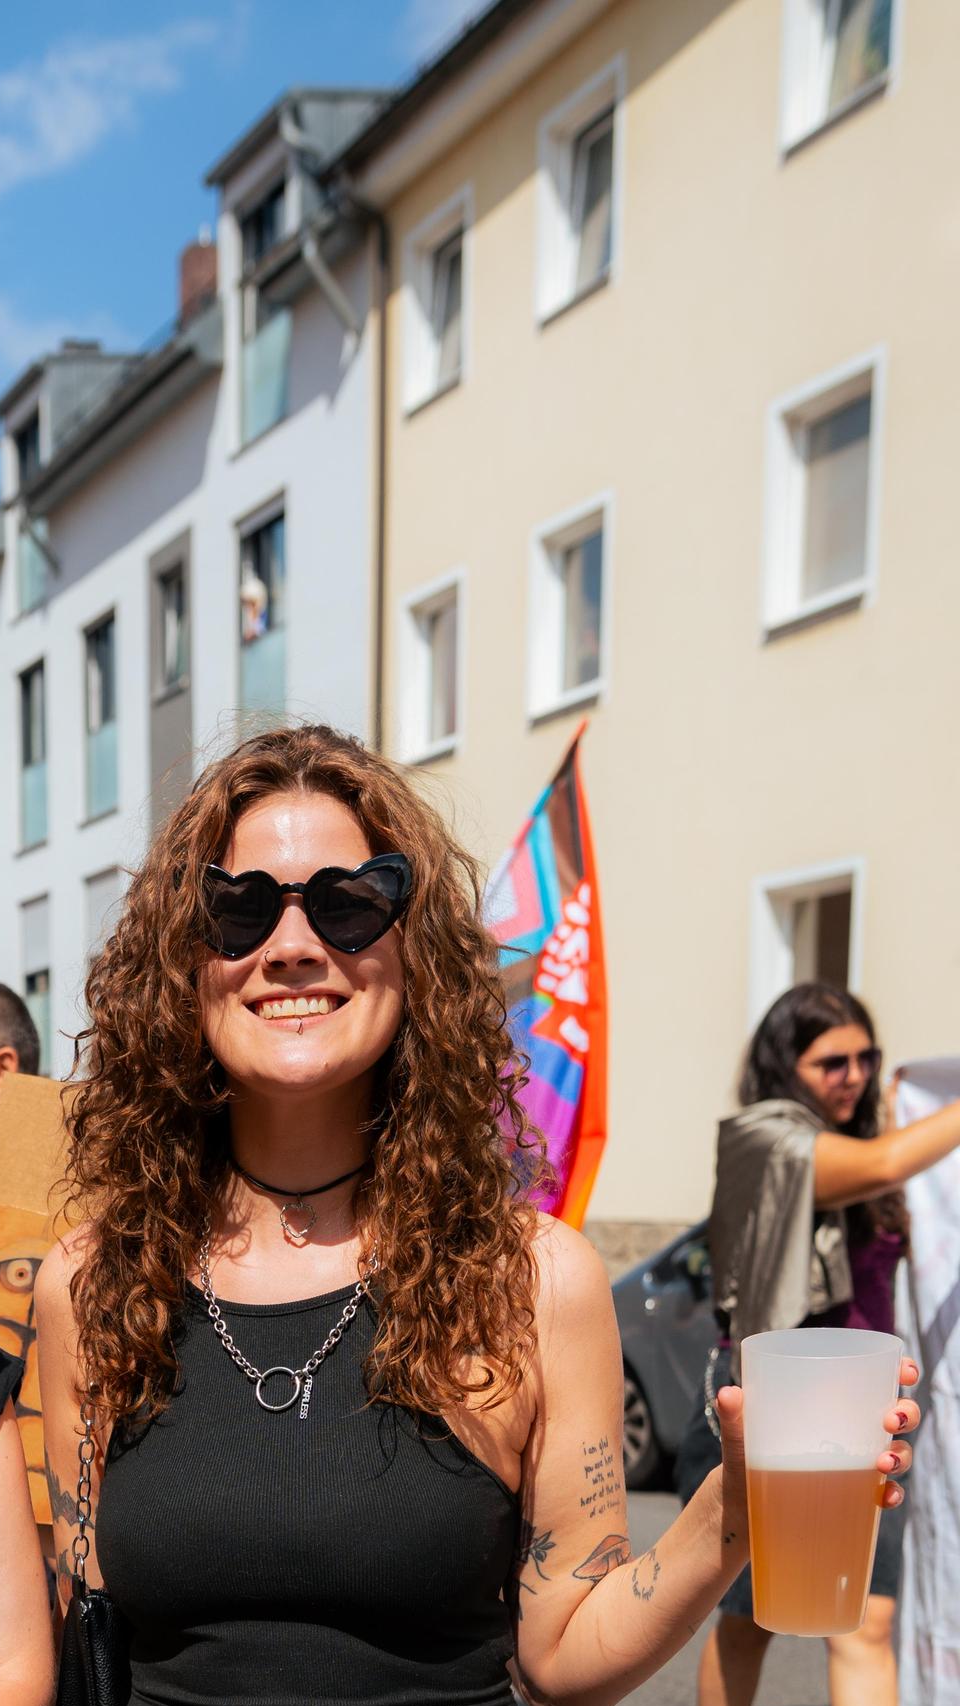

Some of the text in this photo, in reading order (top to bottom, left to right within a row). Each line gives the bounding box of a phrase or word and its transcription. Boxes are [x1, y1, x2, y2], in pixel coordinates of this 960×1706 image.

[300, 1377, 313, 1419] FEARLESS
[588, 1446, 597, 1454] am
[599, 1435, 609, 1456] glad
[584, 1466, 594, 1479] you
[594, 1460, 603, 1470] are
[592, 1471, 605, 1485] with
[580, 1492, 597, 1508] here
